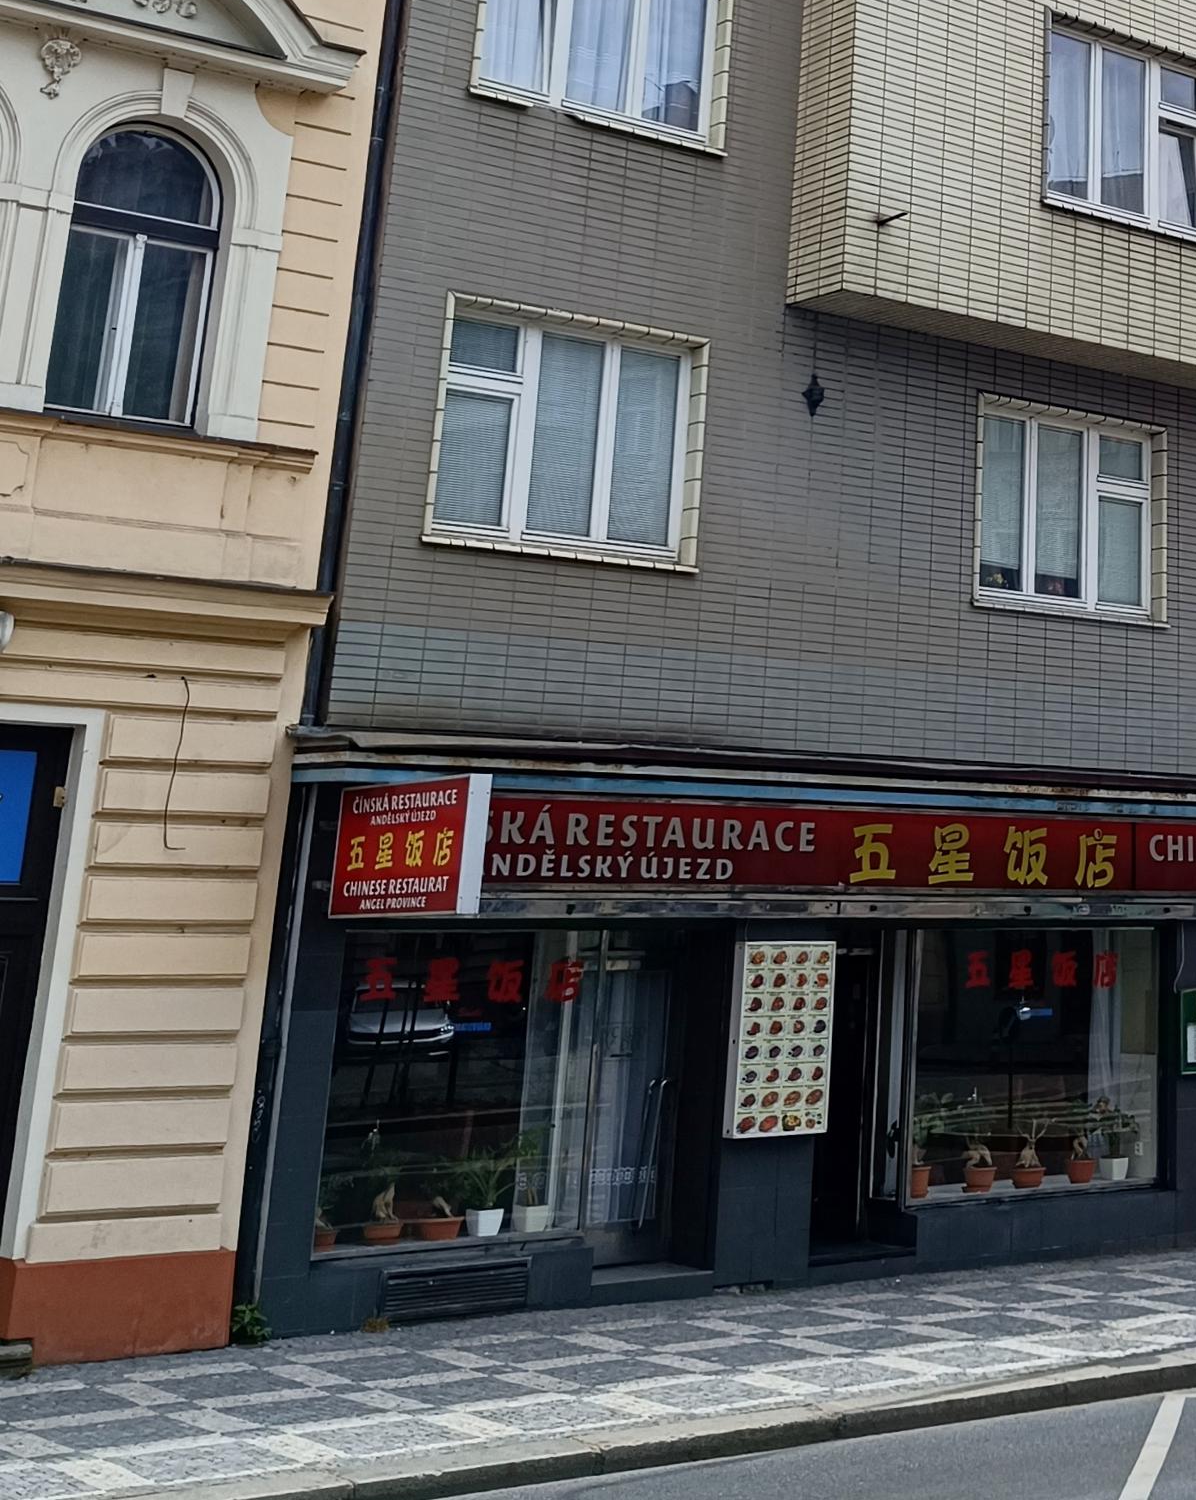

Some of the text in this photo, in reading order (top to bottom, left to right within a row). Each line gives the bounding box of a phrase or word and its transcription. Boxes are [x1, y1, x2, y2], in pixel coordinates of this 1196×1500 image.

[352, 788, 459, 815] ČÍNSKÁ RESTAURACE
[566, 812, 816, 853] RESTAURACE
[346, 827, 455, 872] 五星饭店
[484, 849, 734, 881] NDĚLSKÝ ÚJEZD
[849, 822, 1118, 889] 五星饭店
[343, 875, 450, 898] CHINESE RESTAURAT
[359, 896, 427, 911] ANGEL PROVINCE
